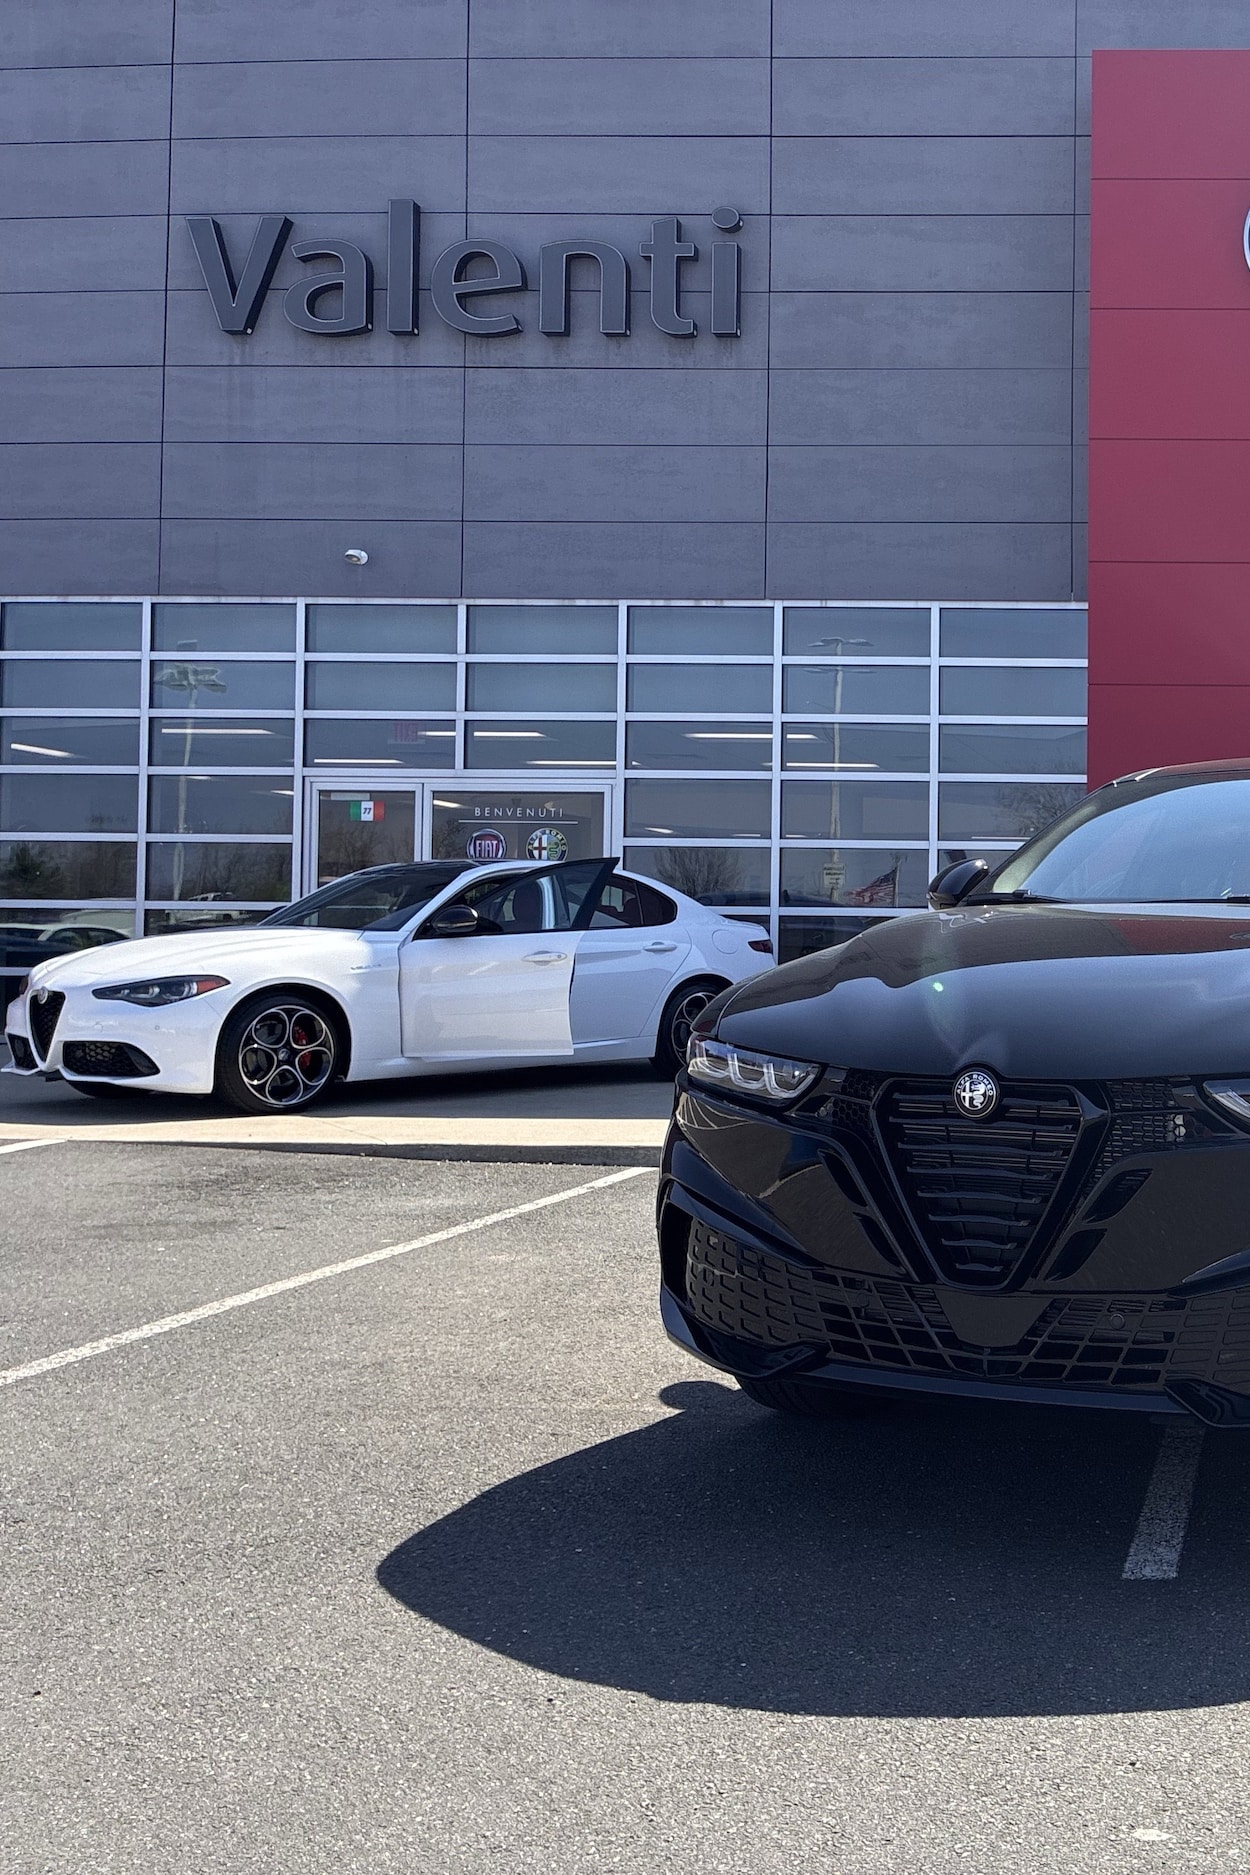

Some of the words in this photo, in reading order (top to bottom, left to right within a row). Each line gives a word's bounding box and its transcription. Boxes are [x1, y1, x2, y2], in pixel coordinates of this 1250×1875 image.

[185, 199, 743, 338] Valenti
[474, 807, 563, 817] BENVENUTI
[475, 840, 498, 858] FIAT
[956, 1076, 970, 1095] ALFA
[972, 1074, 993, 1096] ROMEO
